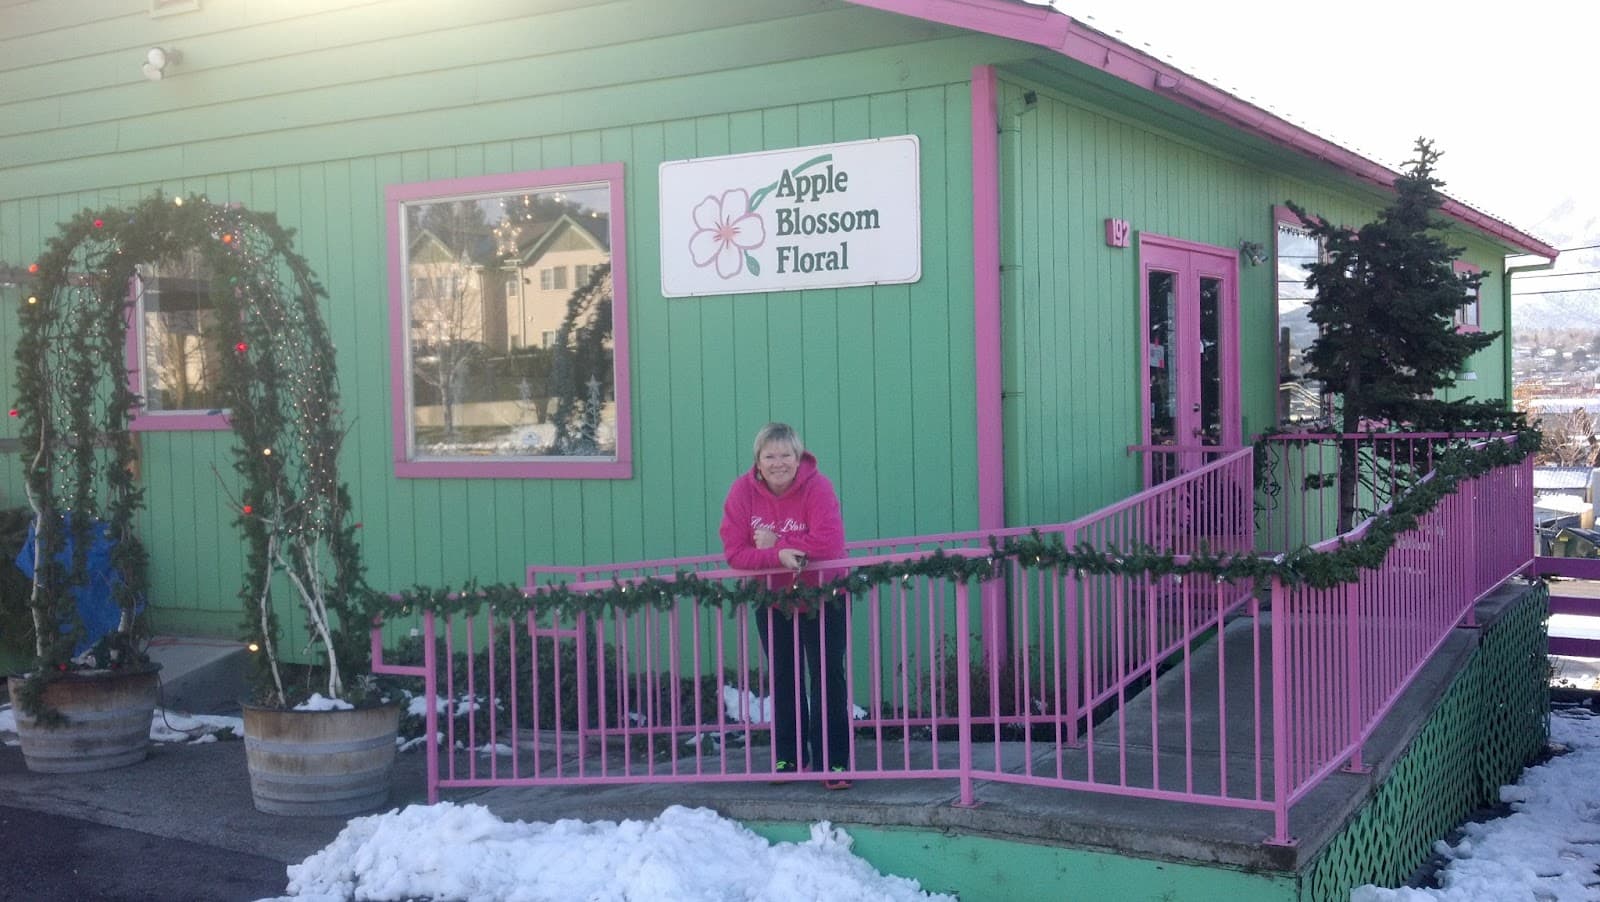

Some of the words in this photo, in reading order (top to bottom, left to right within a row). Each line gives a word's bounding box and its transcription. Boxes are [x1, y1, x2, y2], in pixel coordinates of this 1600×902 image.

[776, 164, 848, 203] Apple
[776, 207, 880, 236] Blossom
[1113, 218, 1130, 247] 192
[776, 241, 849, 274] Floral
